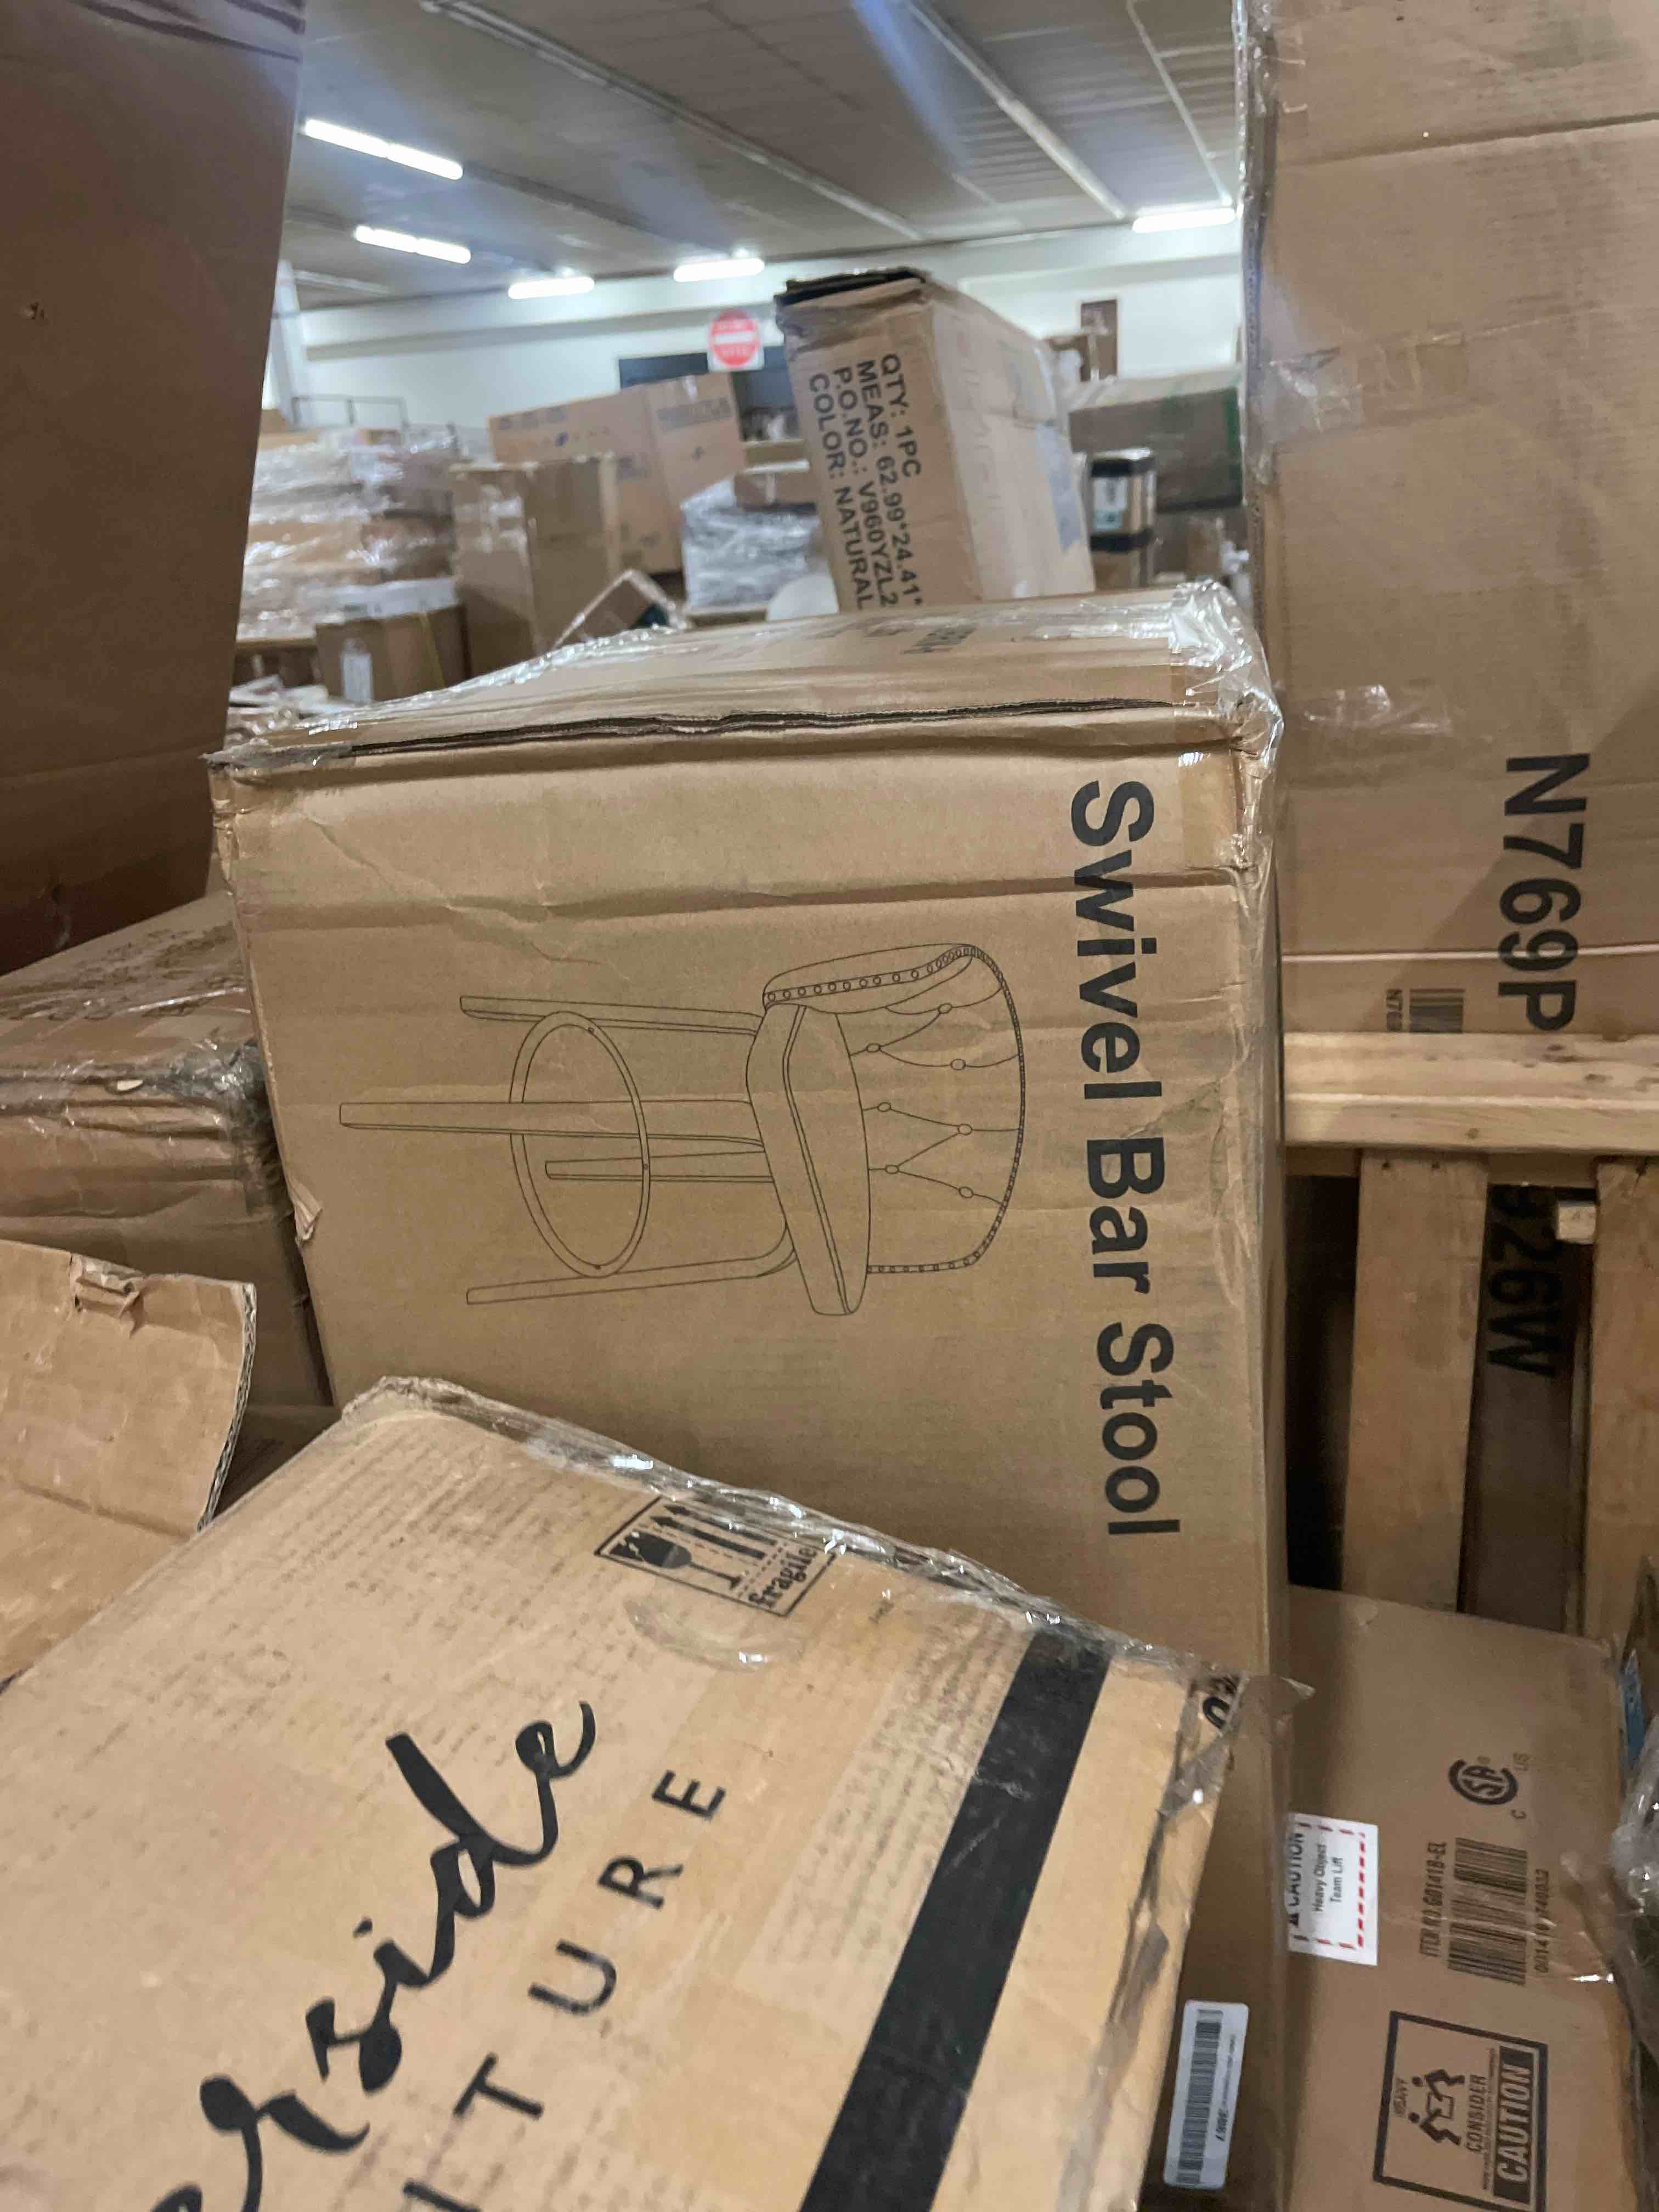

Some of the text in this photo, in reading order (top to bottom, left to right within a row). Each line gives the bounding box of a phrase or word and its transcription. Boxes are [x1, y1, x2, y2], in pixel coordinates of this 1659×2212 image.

[856, 359, 888, 449] MEAS:
[881, 353, 922, 477] QTY: 1PC
[809, 373, 873, 611] COLOR: NATURAL
[1498, 753, 1591, 1031] N769P
[1071, 780, 1181, 1536] Swivel Bar Stool
[1330, 1857, 1344, 1903] Team Lift
[150, 1700, 596, 2212] rside
[1465, 2073, 1486, 2154] CONSIDER
[1496, 2062, 1532, 2182] CAUTION
